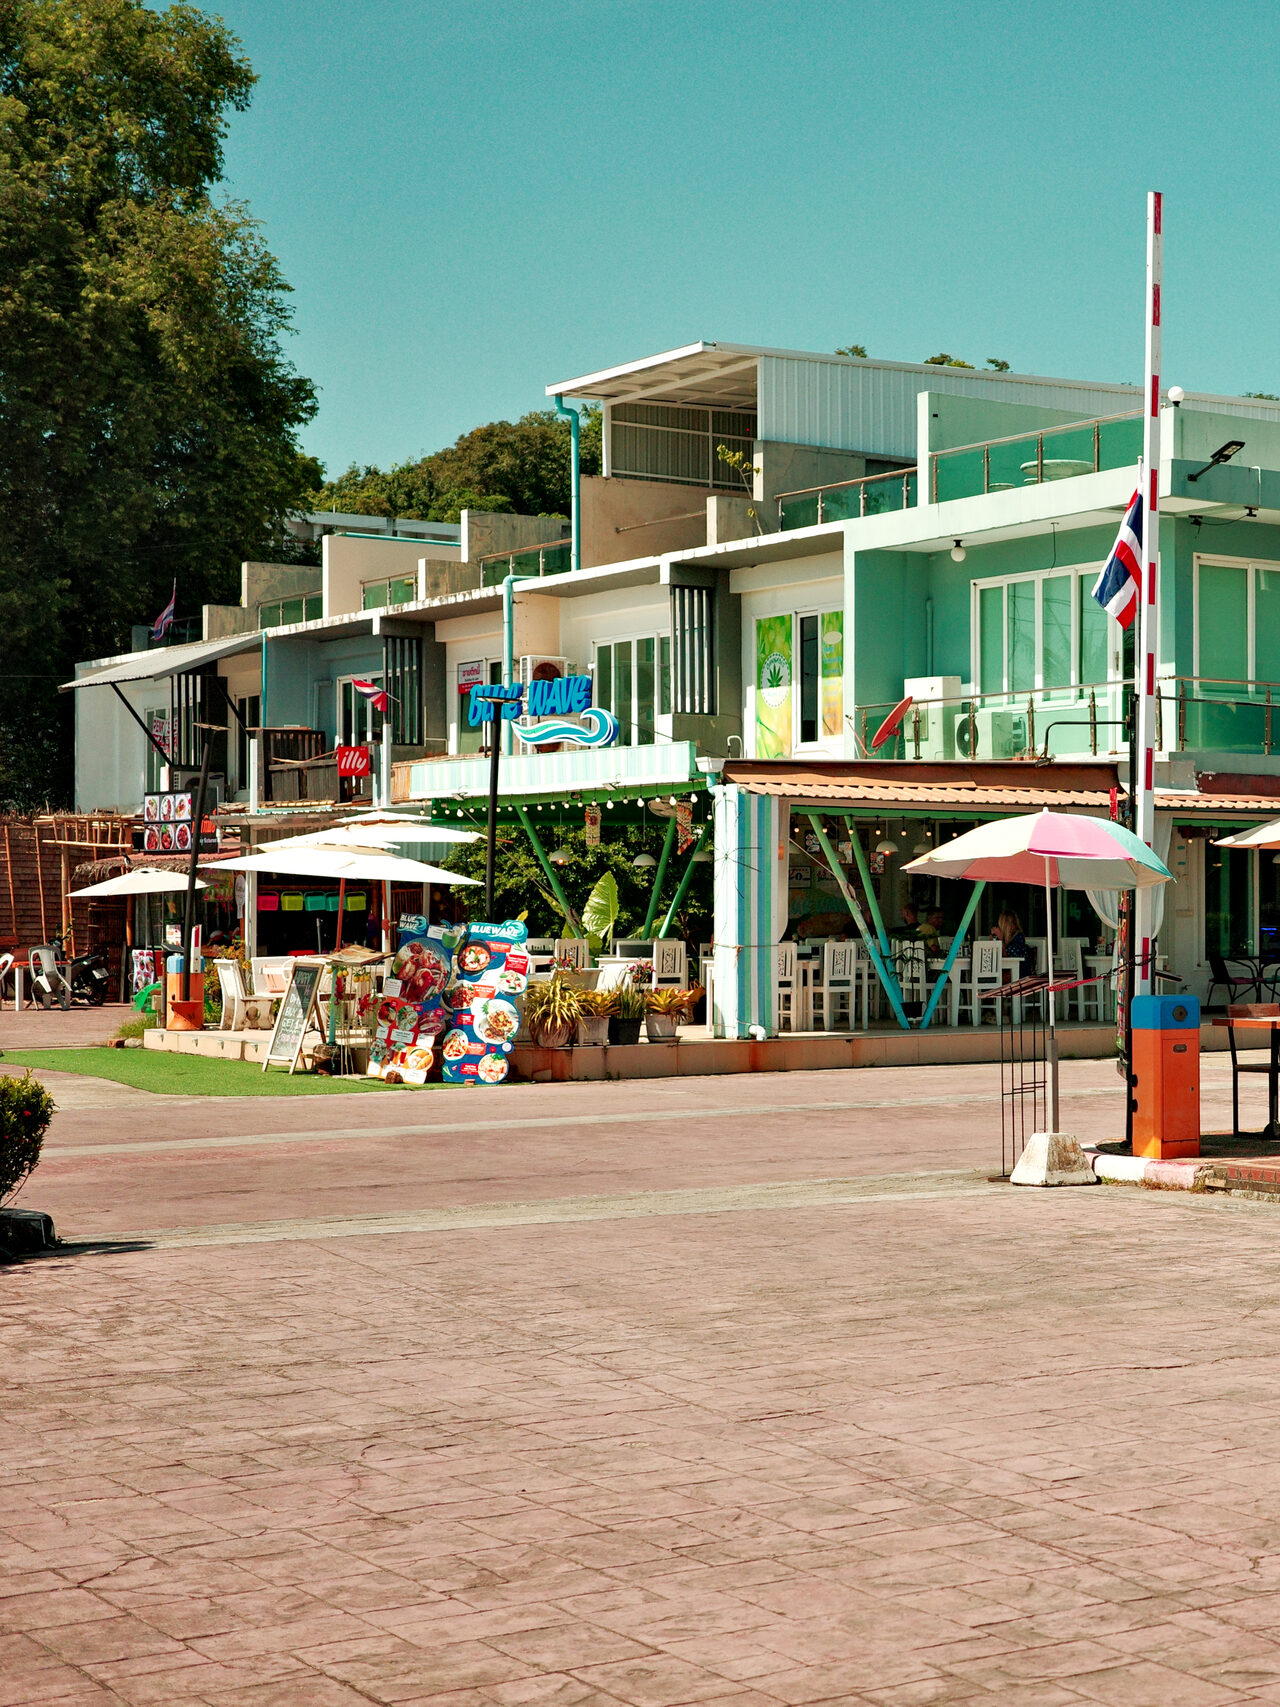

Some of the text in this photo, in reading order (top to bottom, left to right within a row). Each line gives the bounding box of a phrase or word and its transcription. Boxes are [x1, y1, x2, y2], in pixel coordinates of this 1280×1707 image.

[528, 674, 593, 717] WAVE
[340, 750, 367, 774] illy
[399, 914, 417, 923] BLUE
